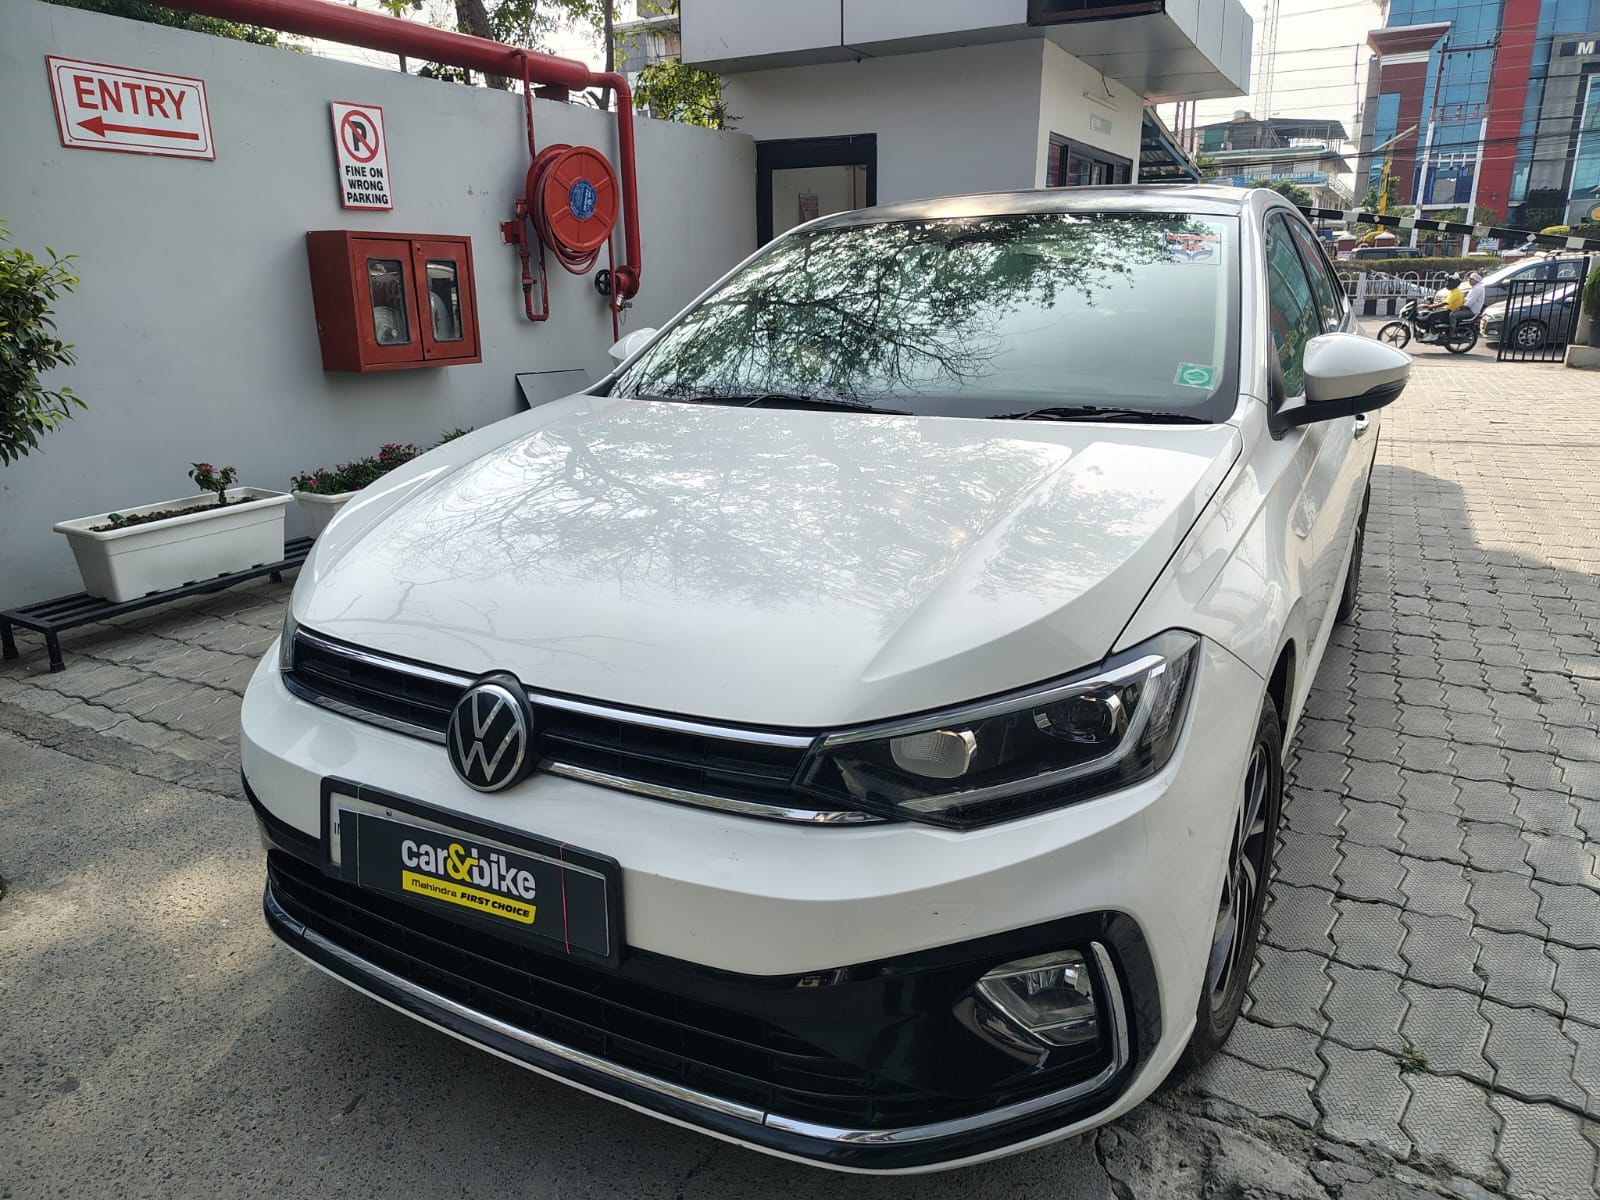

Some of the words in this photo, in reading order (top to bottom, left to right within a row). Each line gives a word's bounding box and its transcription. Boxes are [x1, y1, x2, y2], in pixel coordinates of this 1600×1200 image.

[73, 75, 186, 120] ENTRY
[345, 165, 367, 177] FINE
[369, 167, 384, 178] ON
[346, 192, 389, 204] PARKING
[348, 179, 384, 191] WRONG
[401, 839, 536, 900] car&bike
[411, 878, 457, 898] mahindra
[460, 892, 491, 906] FIRST
[491, 900, 530, 918] CHOICE
